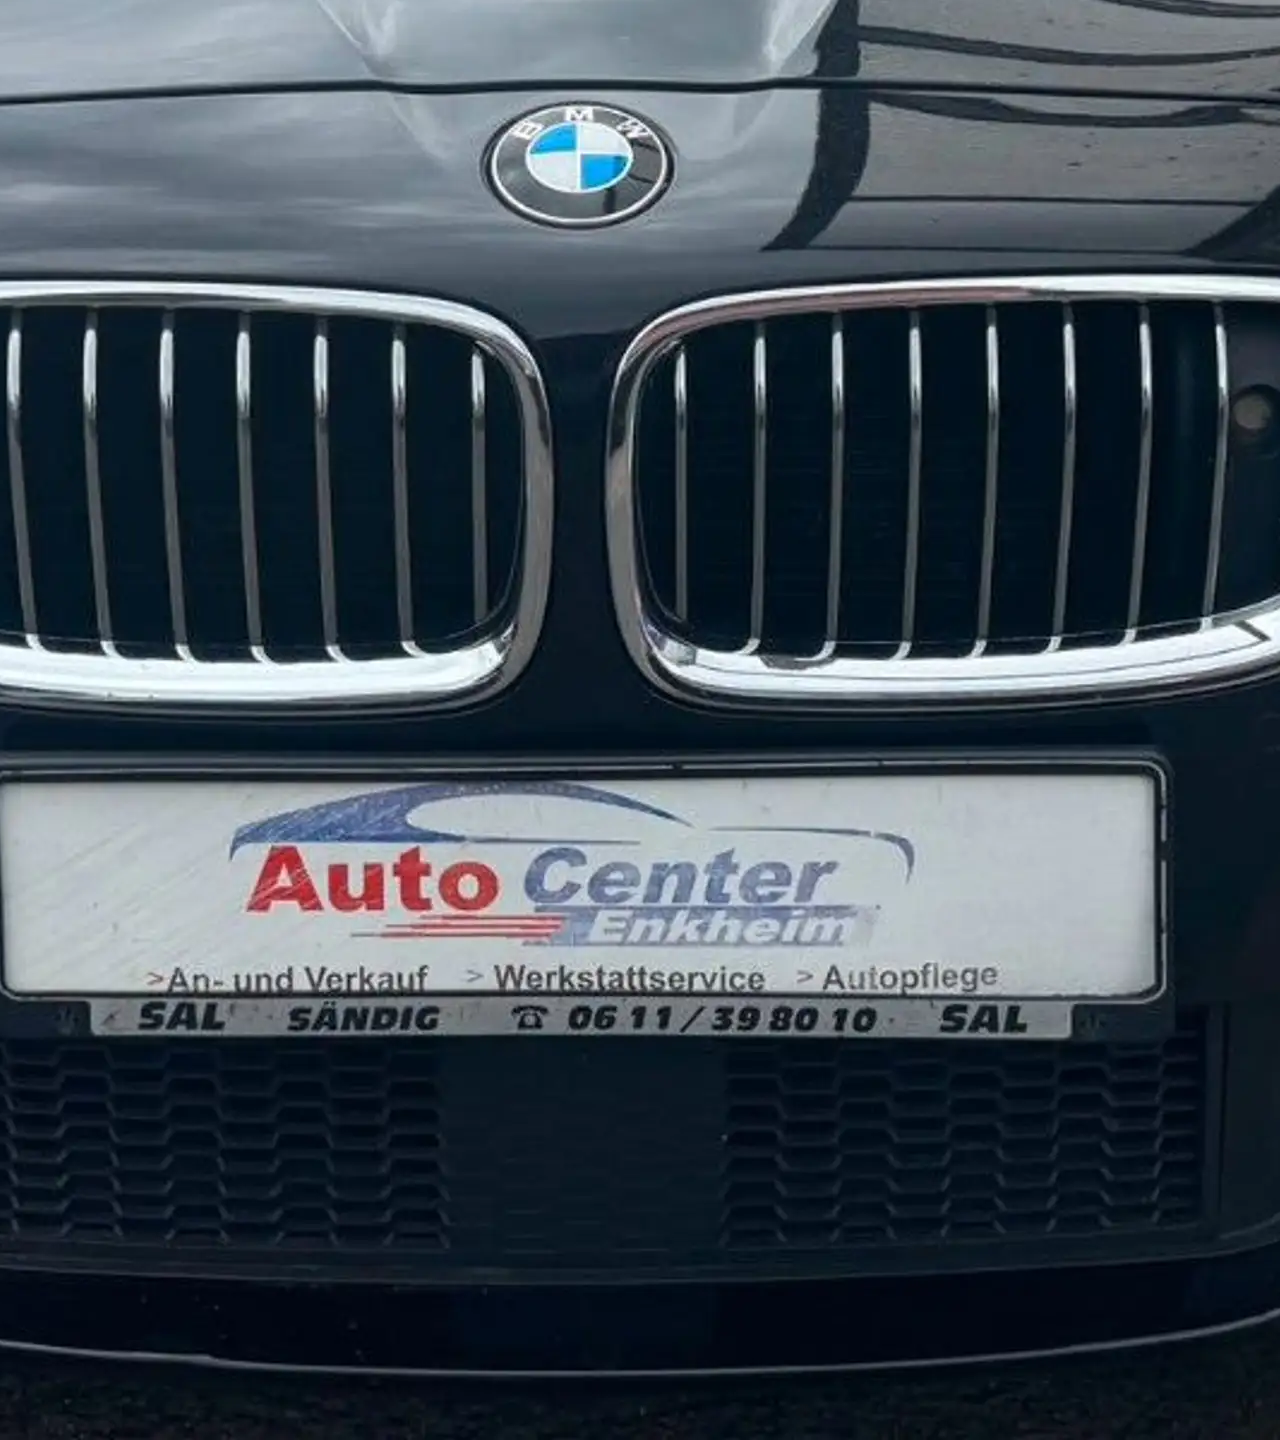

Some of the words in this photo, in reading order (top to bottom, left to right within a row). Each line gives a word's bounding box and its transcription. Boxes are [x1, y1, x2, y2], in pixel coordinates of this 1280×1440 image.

[511, 107, 649, 140] BMW
[246, 845, 500, 913] Auto
[523, 846, 840, 905] Center
[588, 907, 858, 946] Enkheim
[233, 966, 293, 992] und
[304, 965, 428, 993] Verkauf
[493, 964, 766, 993] Werkstattservice
[822, 964, 999, 995] Autopflege
[138, 1002, 226, 1032] SAL
[287, 1001, 440, 1032] SÄNDIG
[940, 1003, 1029, 1033] SAL
